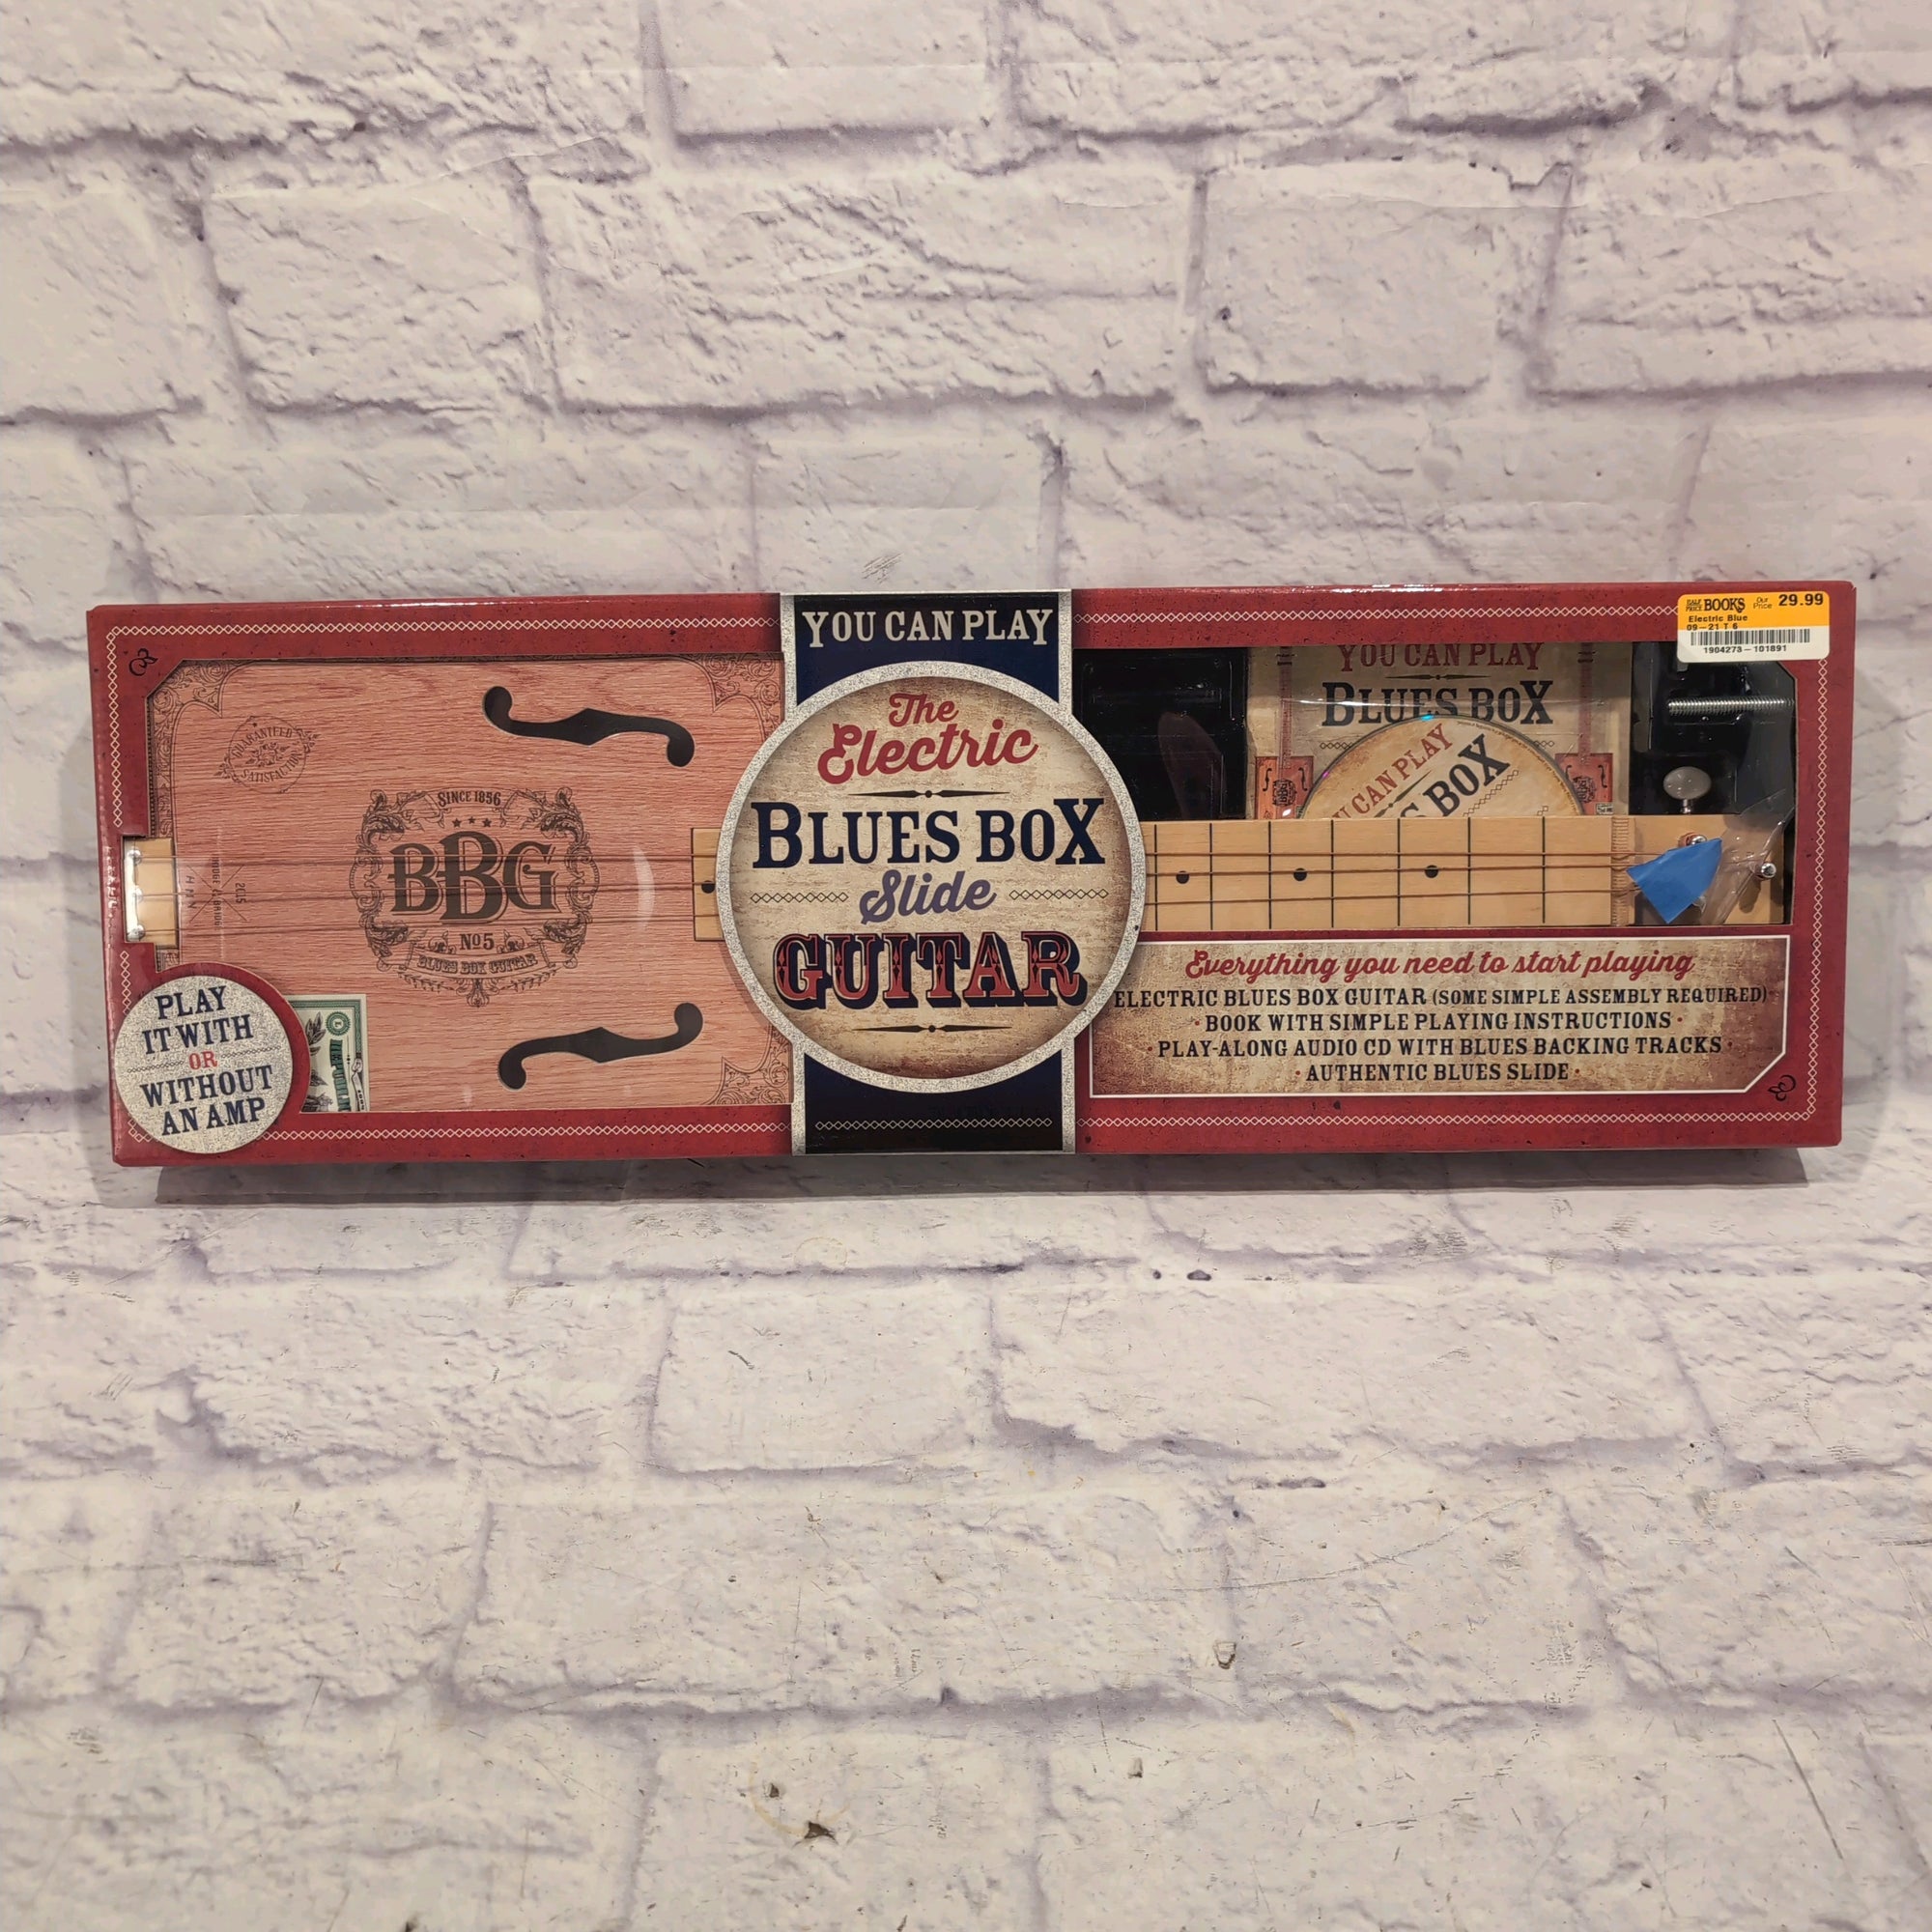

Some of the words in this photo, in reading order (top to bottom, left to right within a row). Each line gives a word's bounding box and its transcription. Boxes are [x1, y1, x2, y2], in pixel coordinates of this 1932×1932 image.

[1704, 597, 1746, 613] BOOKS
[1778, 593, 1825, 607] 29.99
[803, 611, 876, 647] YOU
[885, 611, 954, 642] CAN
[962, 609, 1053, 645] PLAY
[1338, 643, 1395, 671] YOU
[1405, 643, 1461, 667] CAN
[1468, 642, 1545, 670] PLAY
[889, 693, 959, 727] The
[1321, 680, 1458, 726] BLUES
[1468, 680, 1553, 724] BOX
[818, 718, 1039, 784] Electric
[1351, 770, 1398, 814] CAN
[1392, 723, 1453, 781] PLAY
[1423, 733, 1511, 817] BOX
[438, 791, 471, 808] SINCE
[752, 802, 961, 868] BLUES
[976, 798, 1106, 866] BOX
[387, 831, 562, 925] BBG
[860, 869, 997, 924] Slide
[417, 952, 458, 975] BLUES
[459, 960, 487, 975] BOX
[489, 952, 538, 975] GUITAR
[773, 931, 1089, 1010] GUITAR
[1185, 950, 1341, 984] Everything
[1344, 956, 1400, 983] you
[1403, 951, 1475, 975] need
[1479, 951, 1509, 974] to
[1513, 951, 1581, 974] start
[1581, 950, 1695, 981] playing
[155, 985, 228, 1020] PLAY
[1114, 989, 1217, 1009] ELECTRIC
[1223, 988, 1292, 1007] BLUES
[1297, 988, 1340, 1006] BOX
[1345, 987, 1427, 1006] GUITAR
[1433, 988, 1488, 1006] (SOME
[1492, 988, 1560, 1005] SIMPLE
[1565, 987, 1663, 1005] ASSEMBLY
[1666, 986, 1768, 1004] REQUIRED)
[142, 1027, 171, 1055] IT
[175, 1014, 254, 1048] WITH
[1206, 1015, 1262, 1033] BOOK
[1267, 1014, 1323, 1032] WITH
[1329, 1014, 1408, 1032] SIMPLE
[1414, 1012, 1508, 1031] PLAYING
[1515, 1011, 1671, 1030] INSTRUCTIONS
[188, 1051, 217, 1070] OR
[1158, 1039, 1288, 1058] PLAY-ALONG
[1293, 1038, 1357, 1057] AUDIO
[1364, 1038, 1391, 1056] CD
[1398, 1037, 1453, 1056] WITH
[1461, 1037, 1527, 1055] BLUES
[1534, 1037, 1630, 1054] BACKING
[1634, 1036, 1721, 1054] TRACKS
[140, 1065, 273, 1108] WITHOUT
[1306, 1064, 1427, 1081] AUTHENTIC
[1434, 1064, 1501, 1081] BLUES
[1507, 1063, 1569, 1080] SLIDE
[161, 1107, 199, 1136] AN
[206, 1096, 266, 1128] AMP
